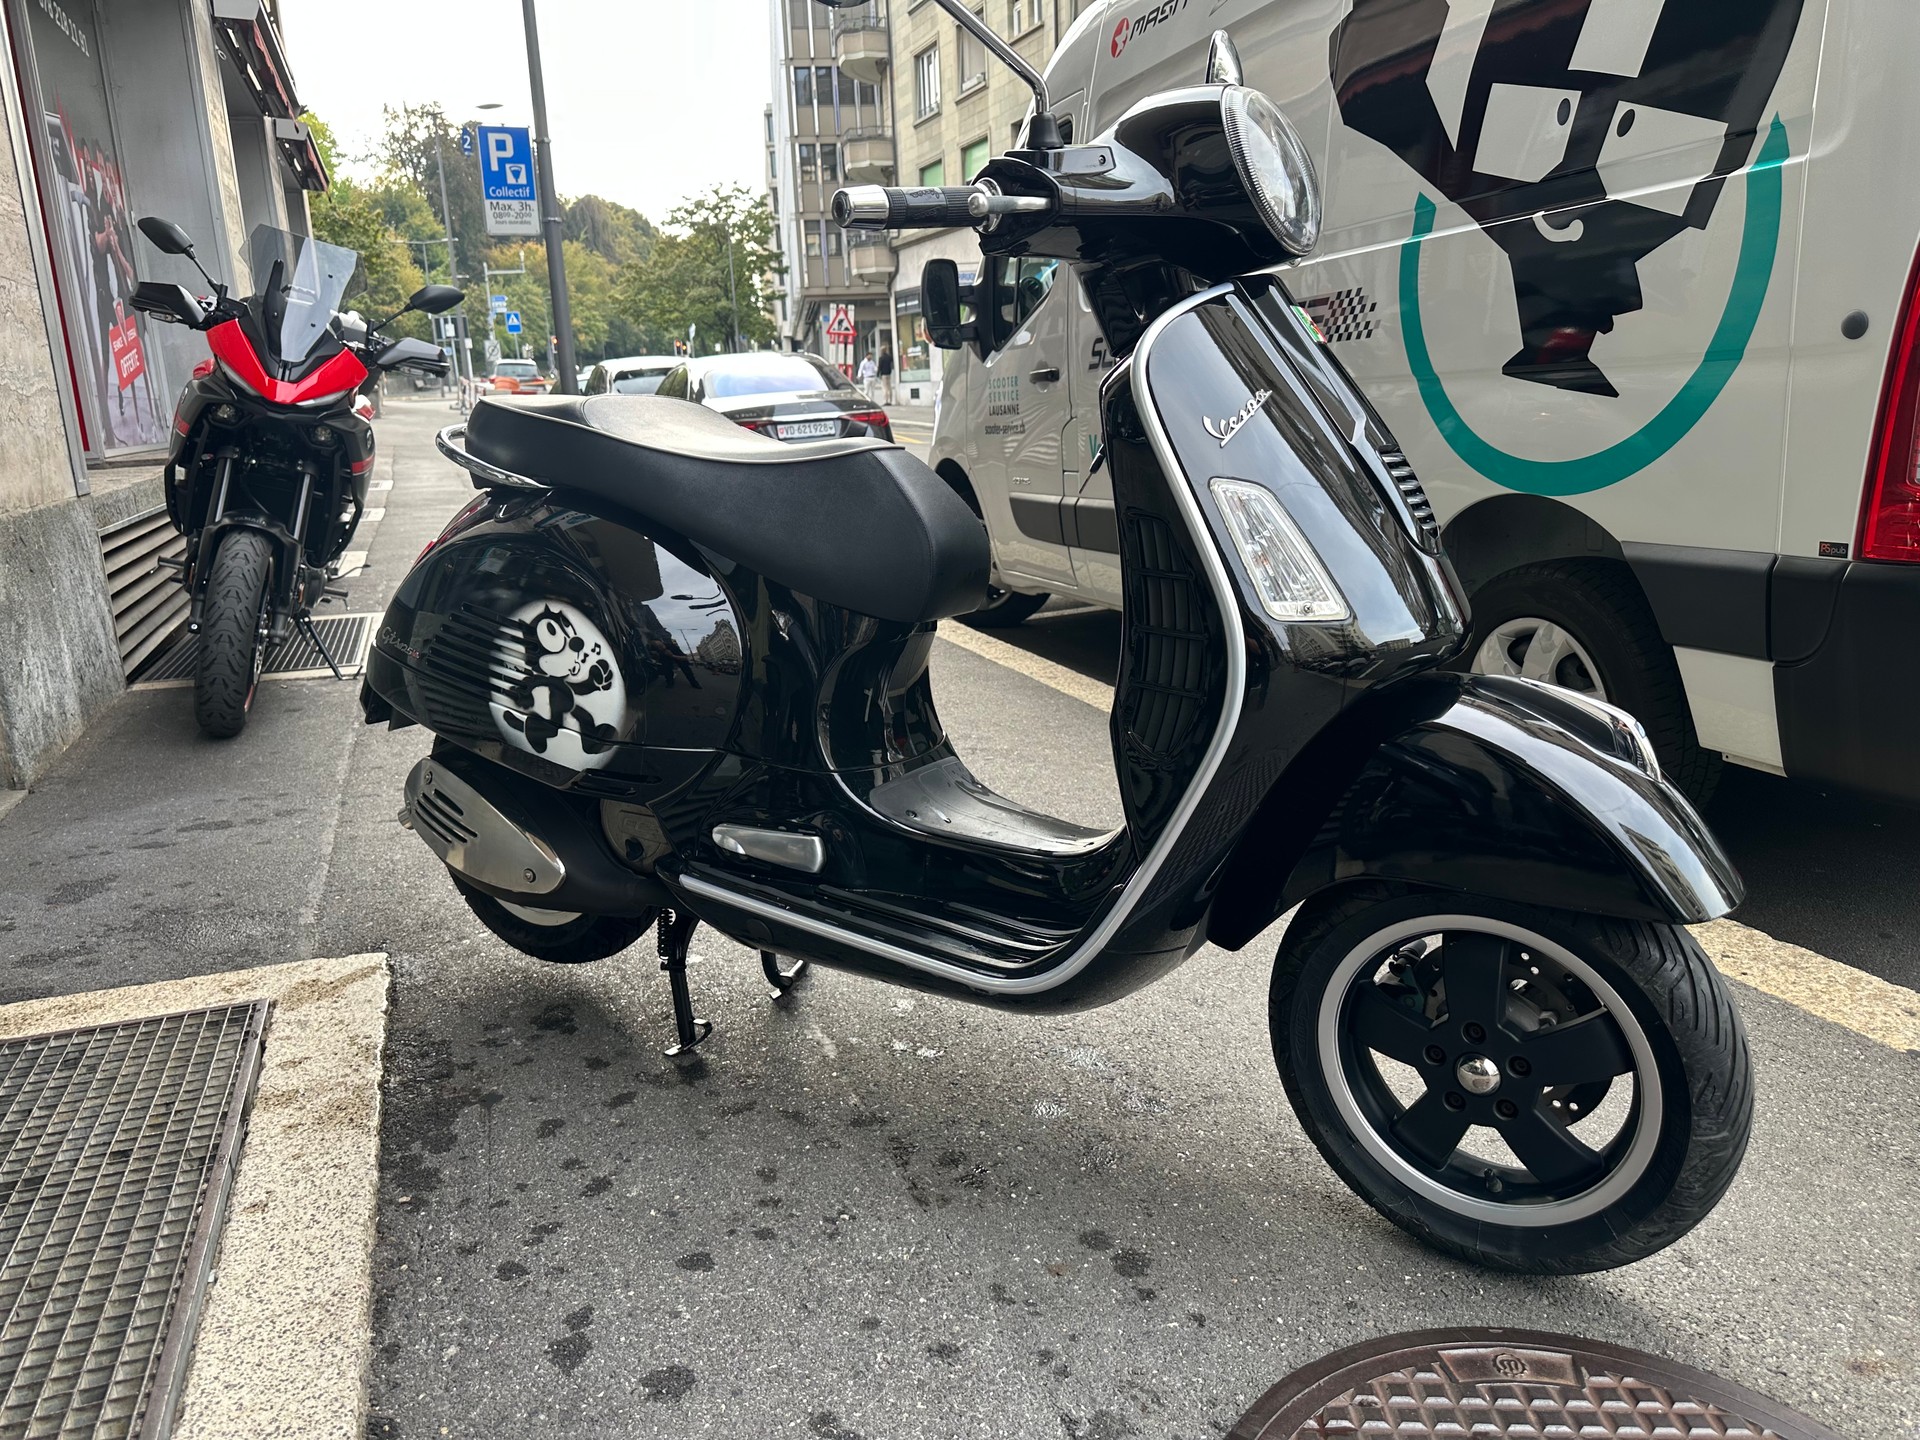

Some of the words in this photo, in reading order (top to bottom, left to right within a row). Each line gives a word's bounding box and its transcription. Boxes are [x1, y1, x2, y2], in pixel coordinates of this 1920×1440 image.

[463, 135, 471, 149] 2
[487, 132, 514, 171] P
[489, 186, 530, 198] Collectif
[489, 201, 516, 212] Max.
[518, 201, 535, 212] 3h.
[989, 376, 1018, 389] SCOOTER
[989, 390, 1019, 403] SERVICE
[989, 404, 1020, 416] LAUSANNE
[1202, 388, 1272, 449] Vespa
